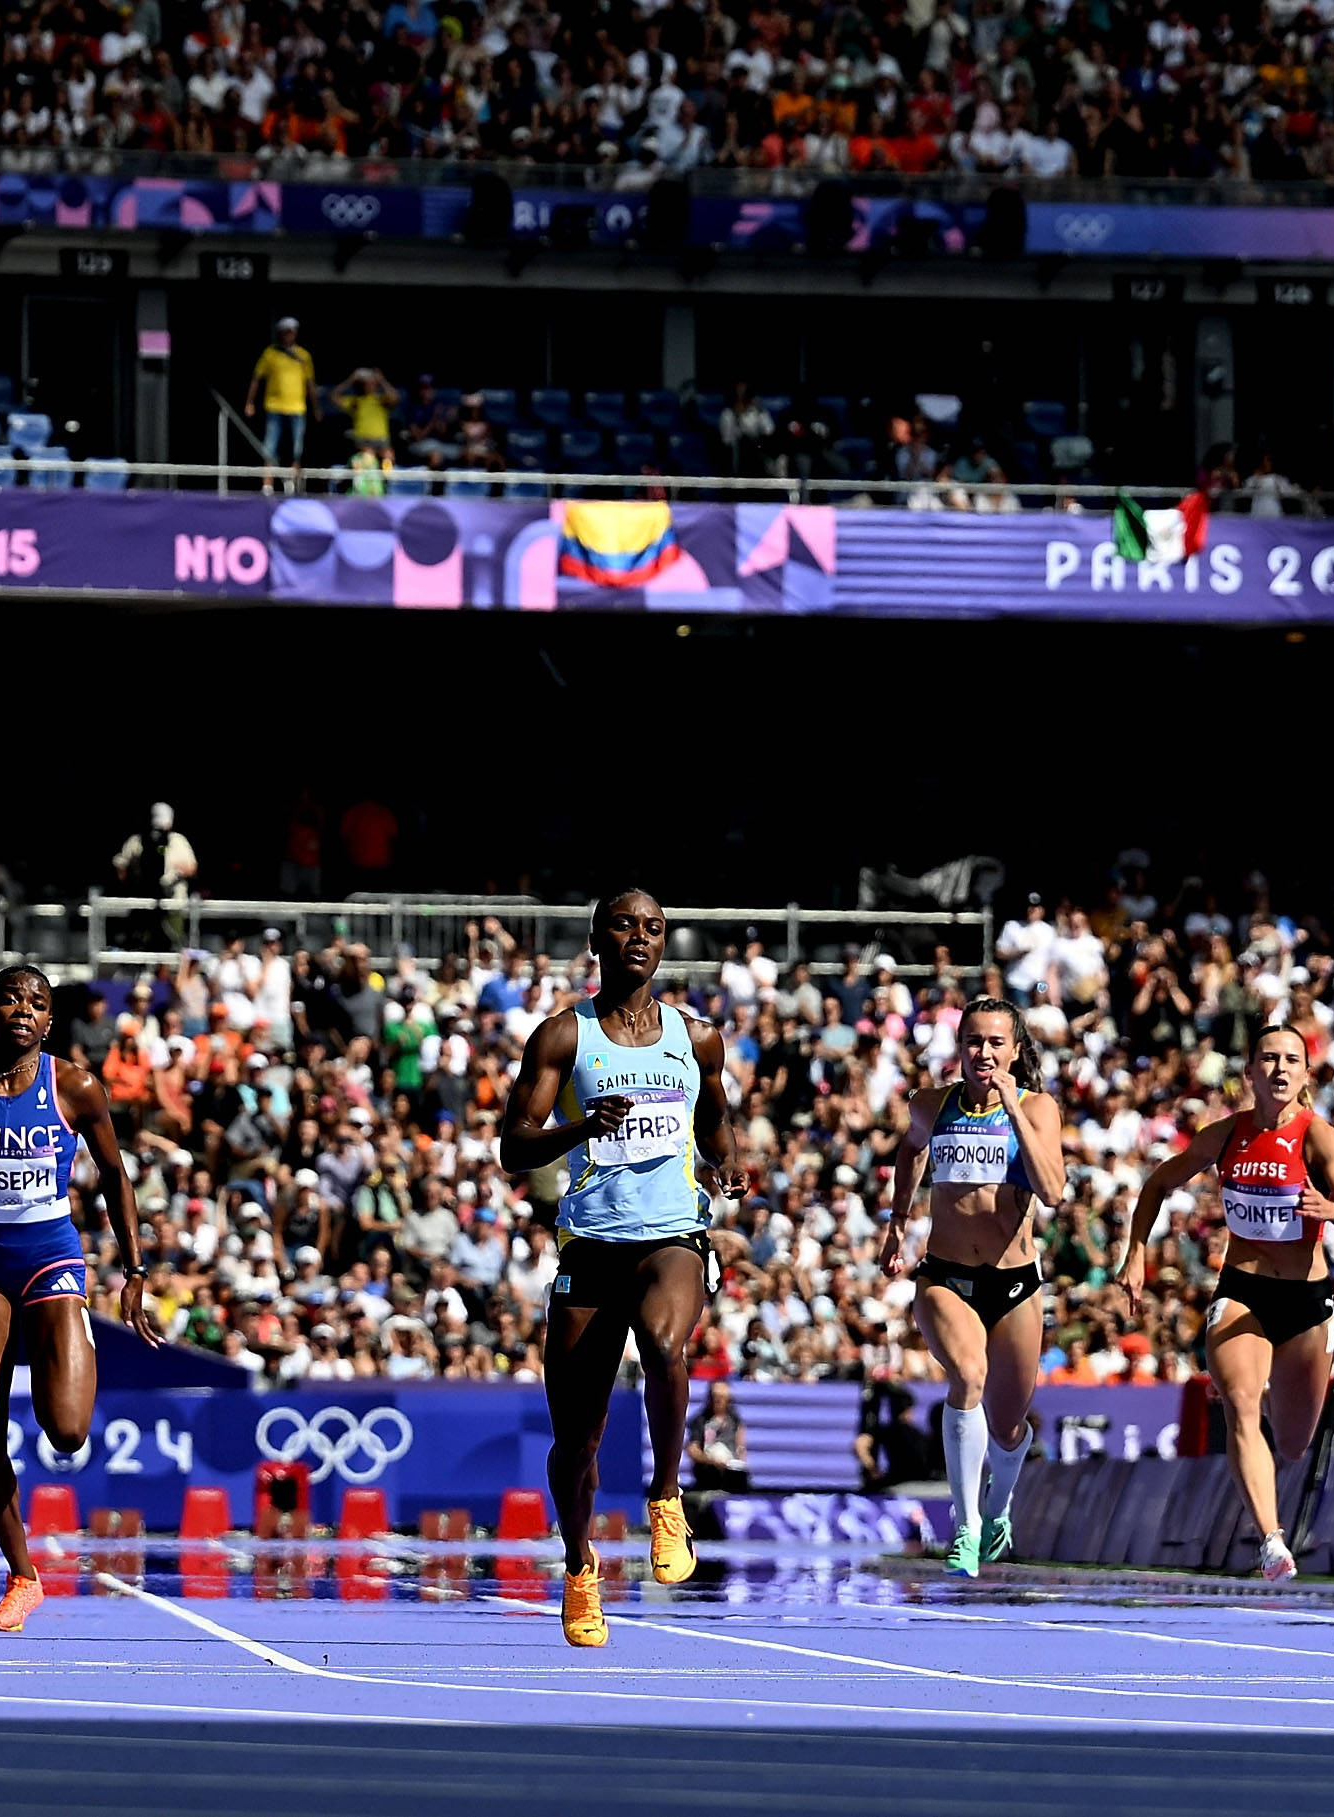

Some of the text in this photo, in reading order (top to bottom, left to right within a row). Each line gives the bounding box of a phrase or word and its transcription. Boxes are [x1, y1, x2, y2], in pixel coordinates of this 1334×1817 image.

[174, 534, 270, 585] N10
[597, 1071, 685, 1093] SAINT LUCIA
[1232, 1161, 1288, 1181] SUISSE
[1224, 1198, 1297, 1224] POINTET
